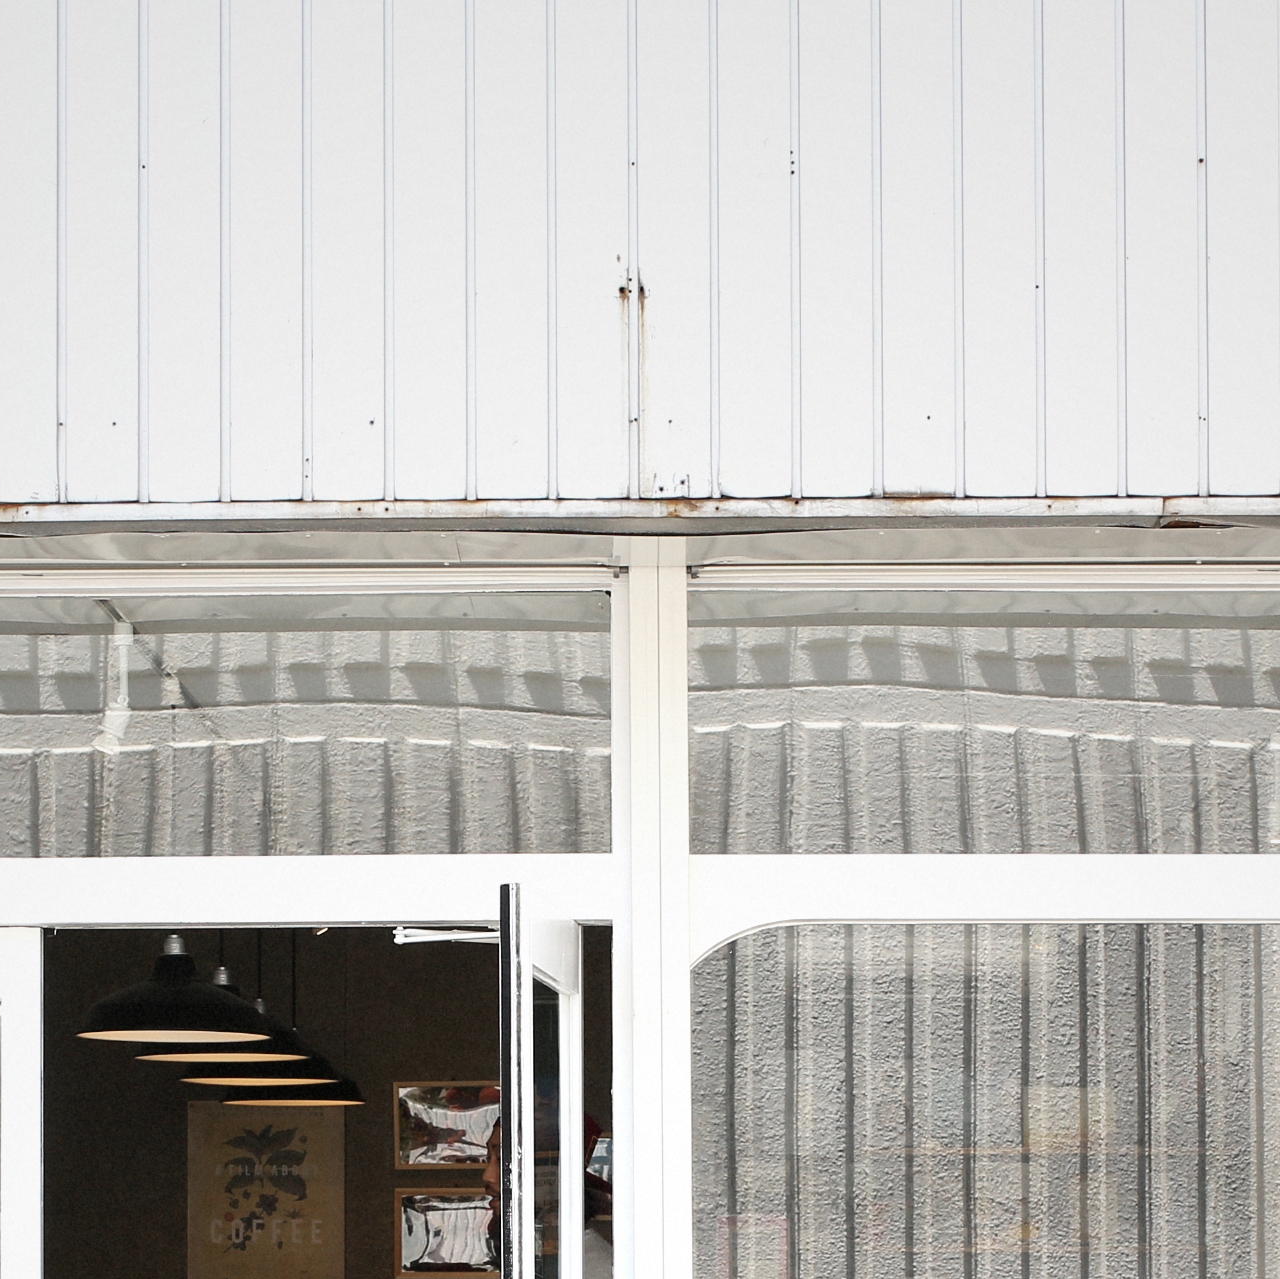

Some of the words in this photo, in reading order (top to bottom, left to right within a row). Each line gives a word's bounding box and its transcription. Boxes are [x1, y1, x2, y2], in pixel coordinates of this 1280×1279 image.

[228, 1165, 264, 1176] FILM
[272, 1164, 318, 1176] ABOUT
[210, 1219, 324, 1244] COFFEE
